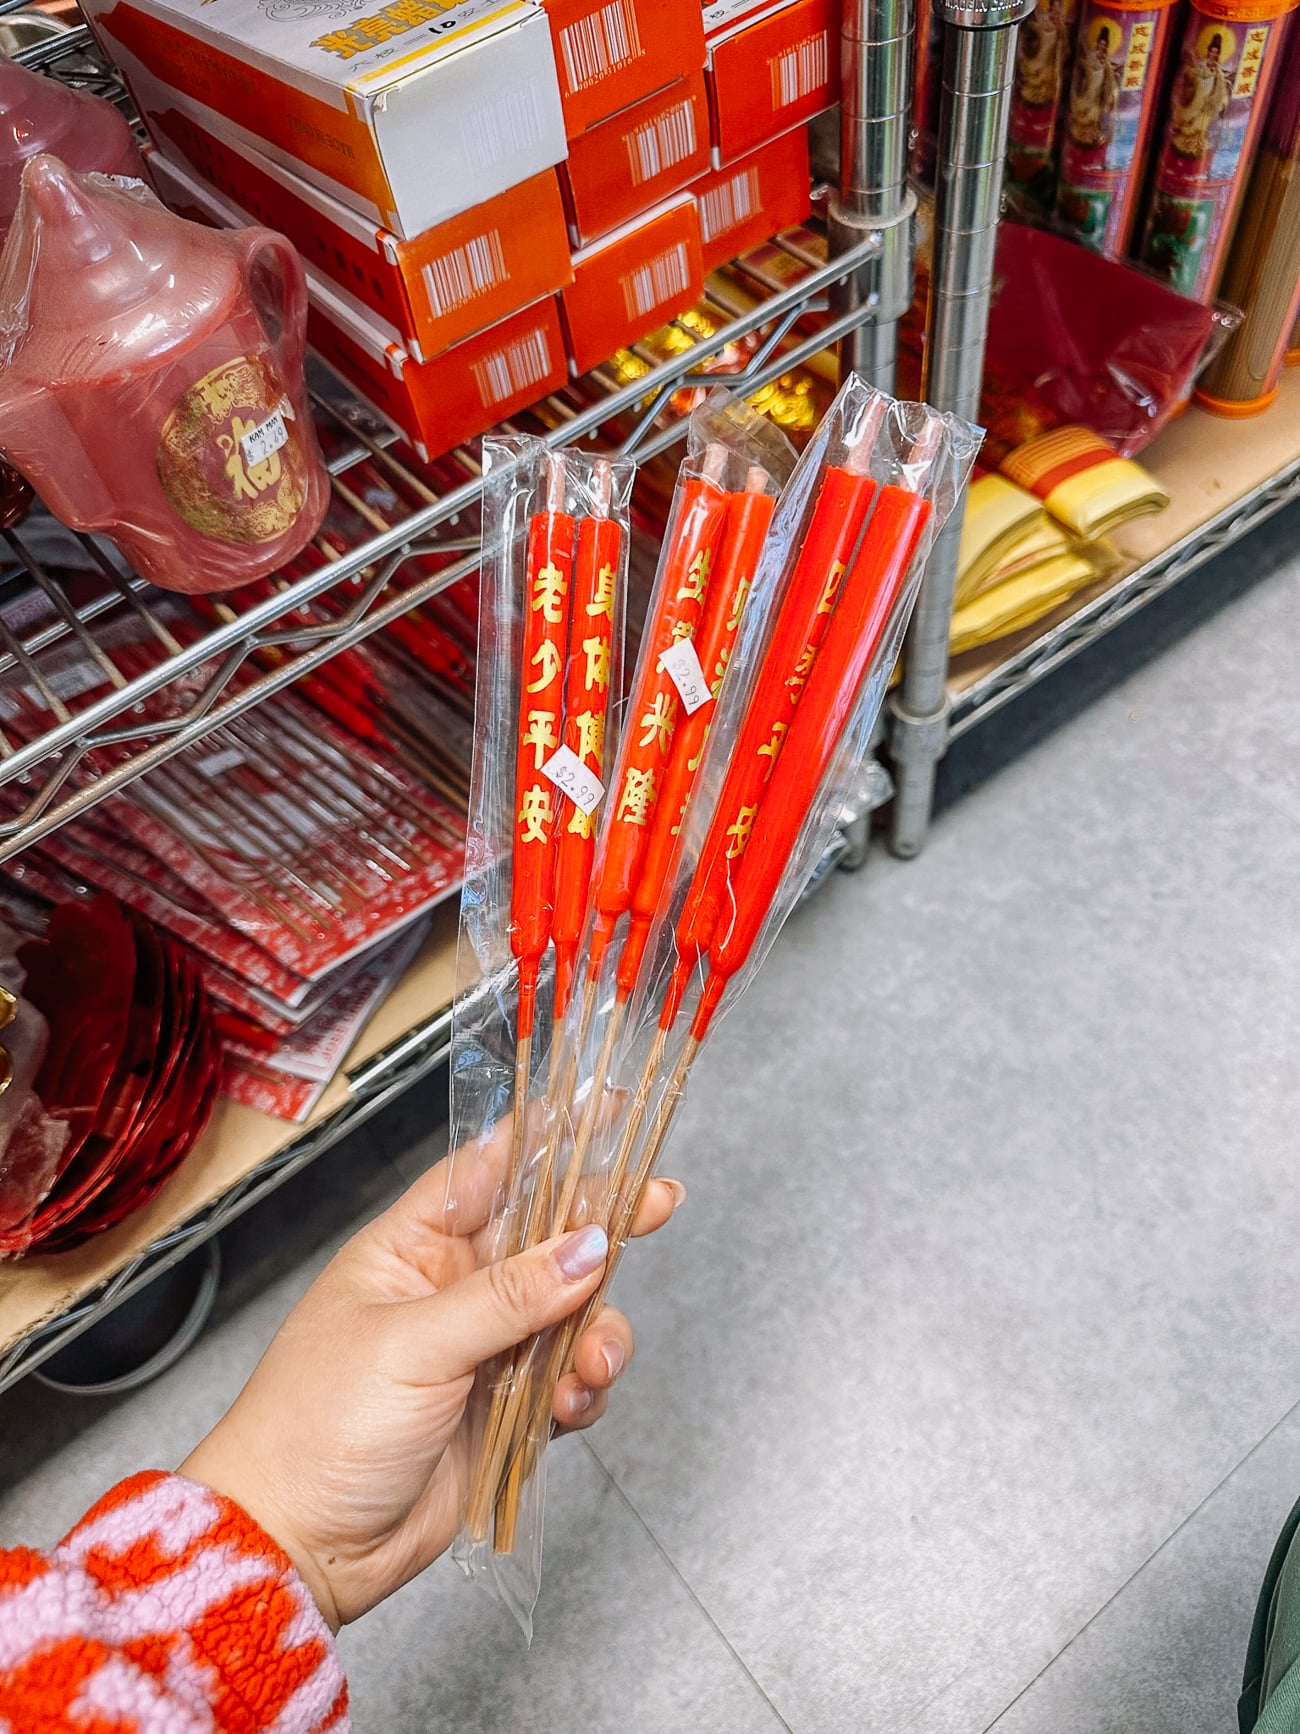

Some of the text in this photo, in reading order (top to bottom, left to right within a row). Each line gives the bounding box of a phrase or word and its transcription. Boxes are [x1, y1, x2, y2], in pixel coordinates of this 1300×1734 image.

[249, 415, 279, 443] KAM MAN
[518, 561, 568, 845] 老少平安
[672, 658, 700, 706] $2.99
[555, 765, 595, 806] $2.99
